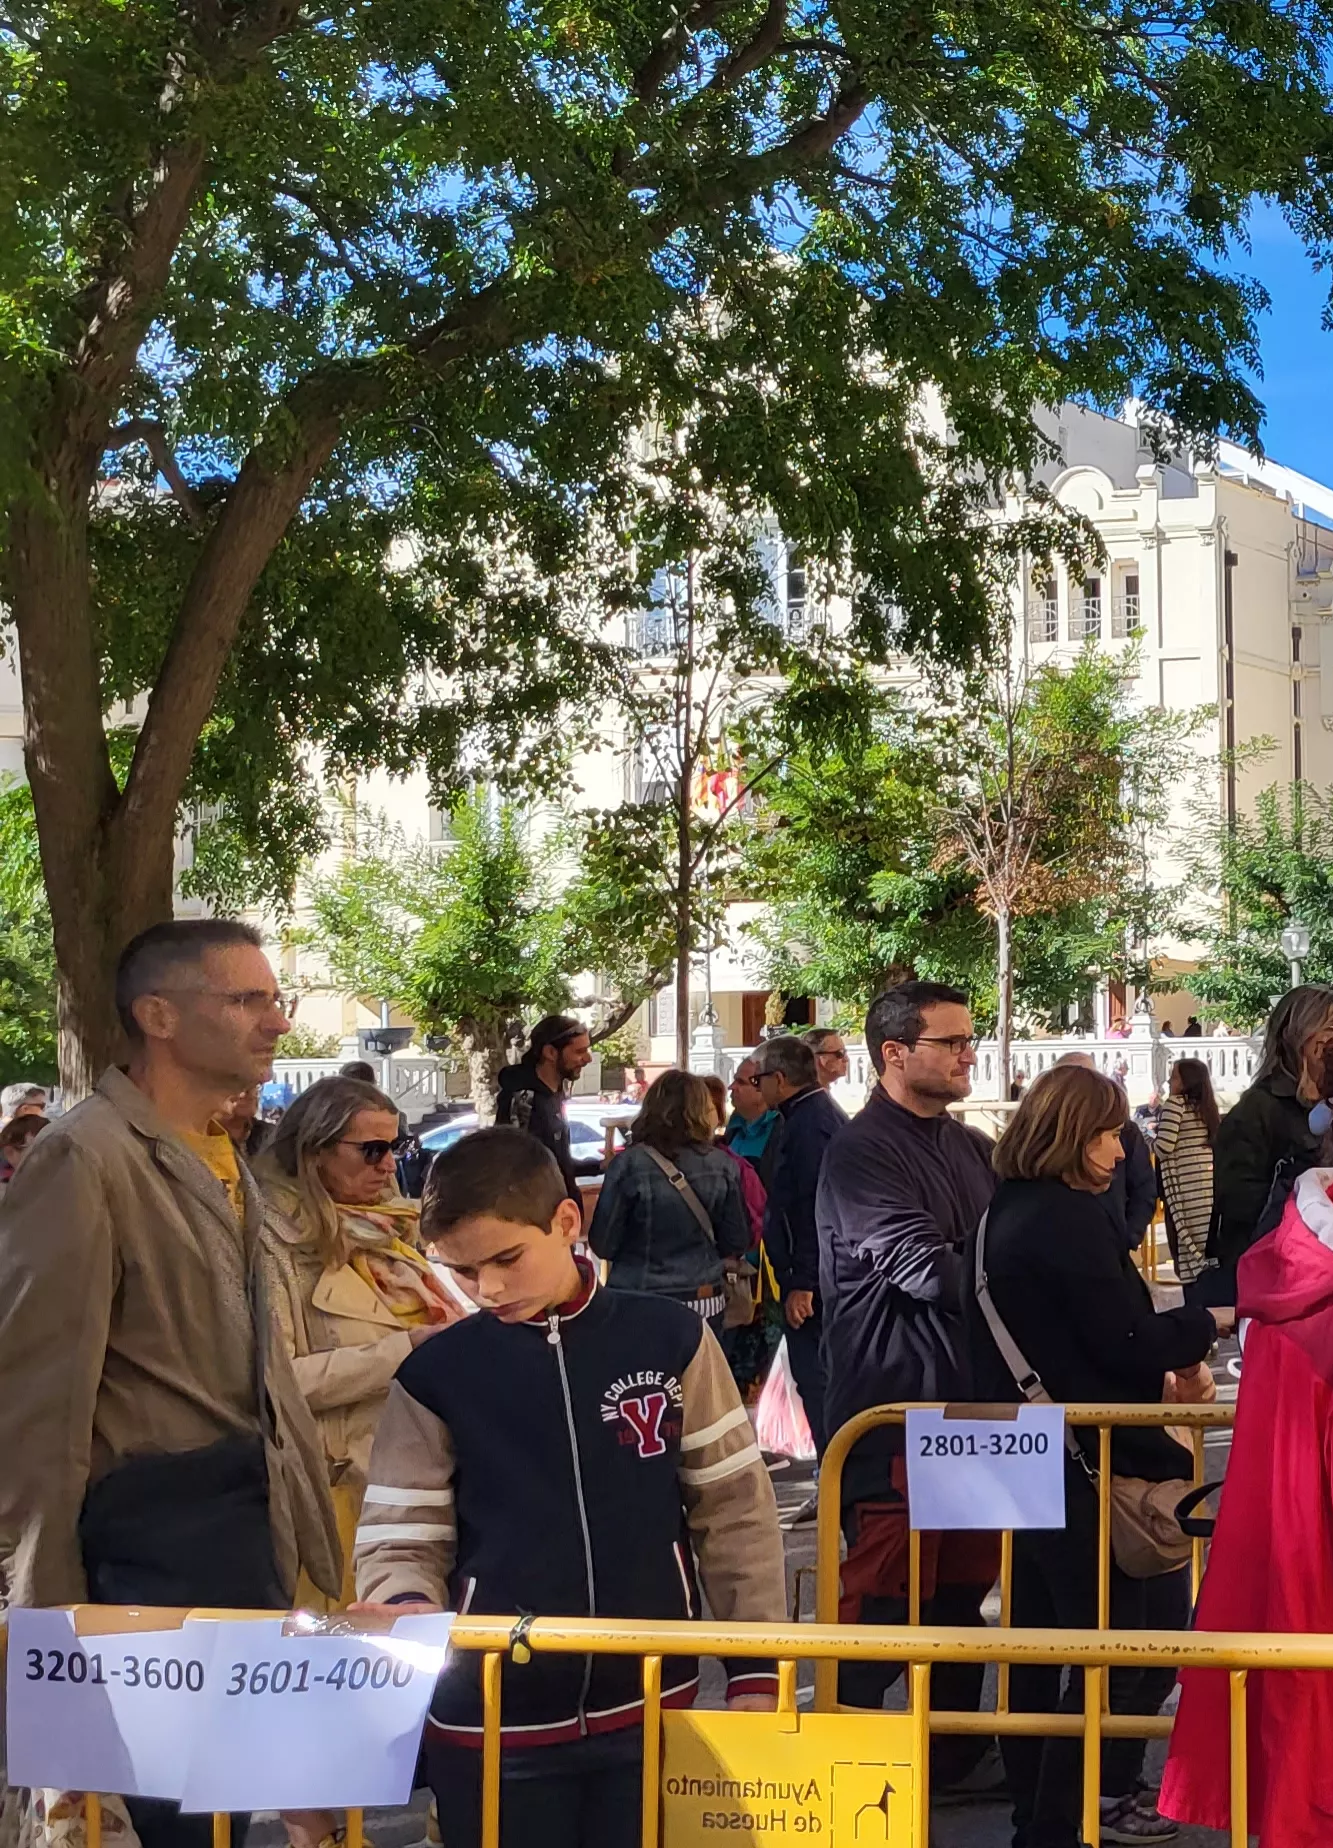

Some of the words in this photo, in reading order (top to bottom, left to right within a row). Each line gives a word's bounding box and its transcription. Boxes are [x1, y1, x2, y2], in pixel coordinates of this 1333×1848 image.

[604, 1370, 664, 1402] COLLEGE
[600, 1404, 619, 1422] NY
[620, 1392, 667, 1458] Y
[920, 1432, 1049, 1457] 2801-3200
[26, 1648, 205, 1692] 3201-3600
[226, 1655, 415, 1696] 3601-4000
